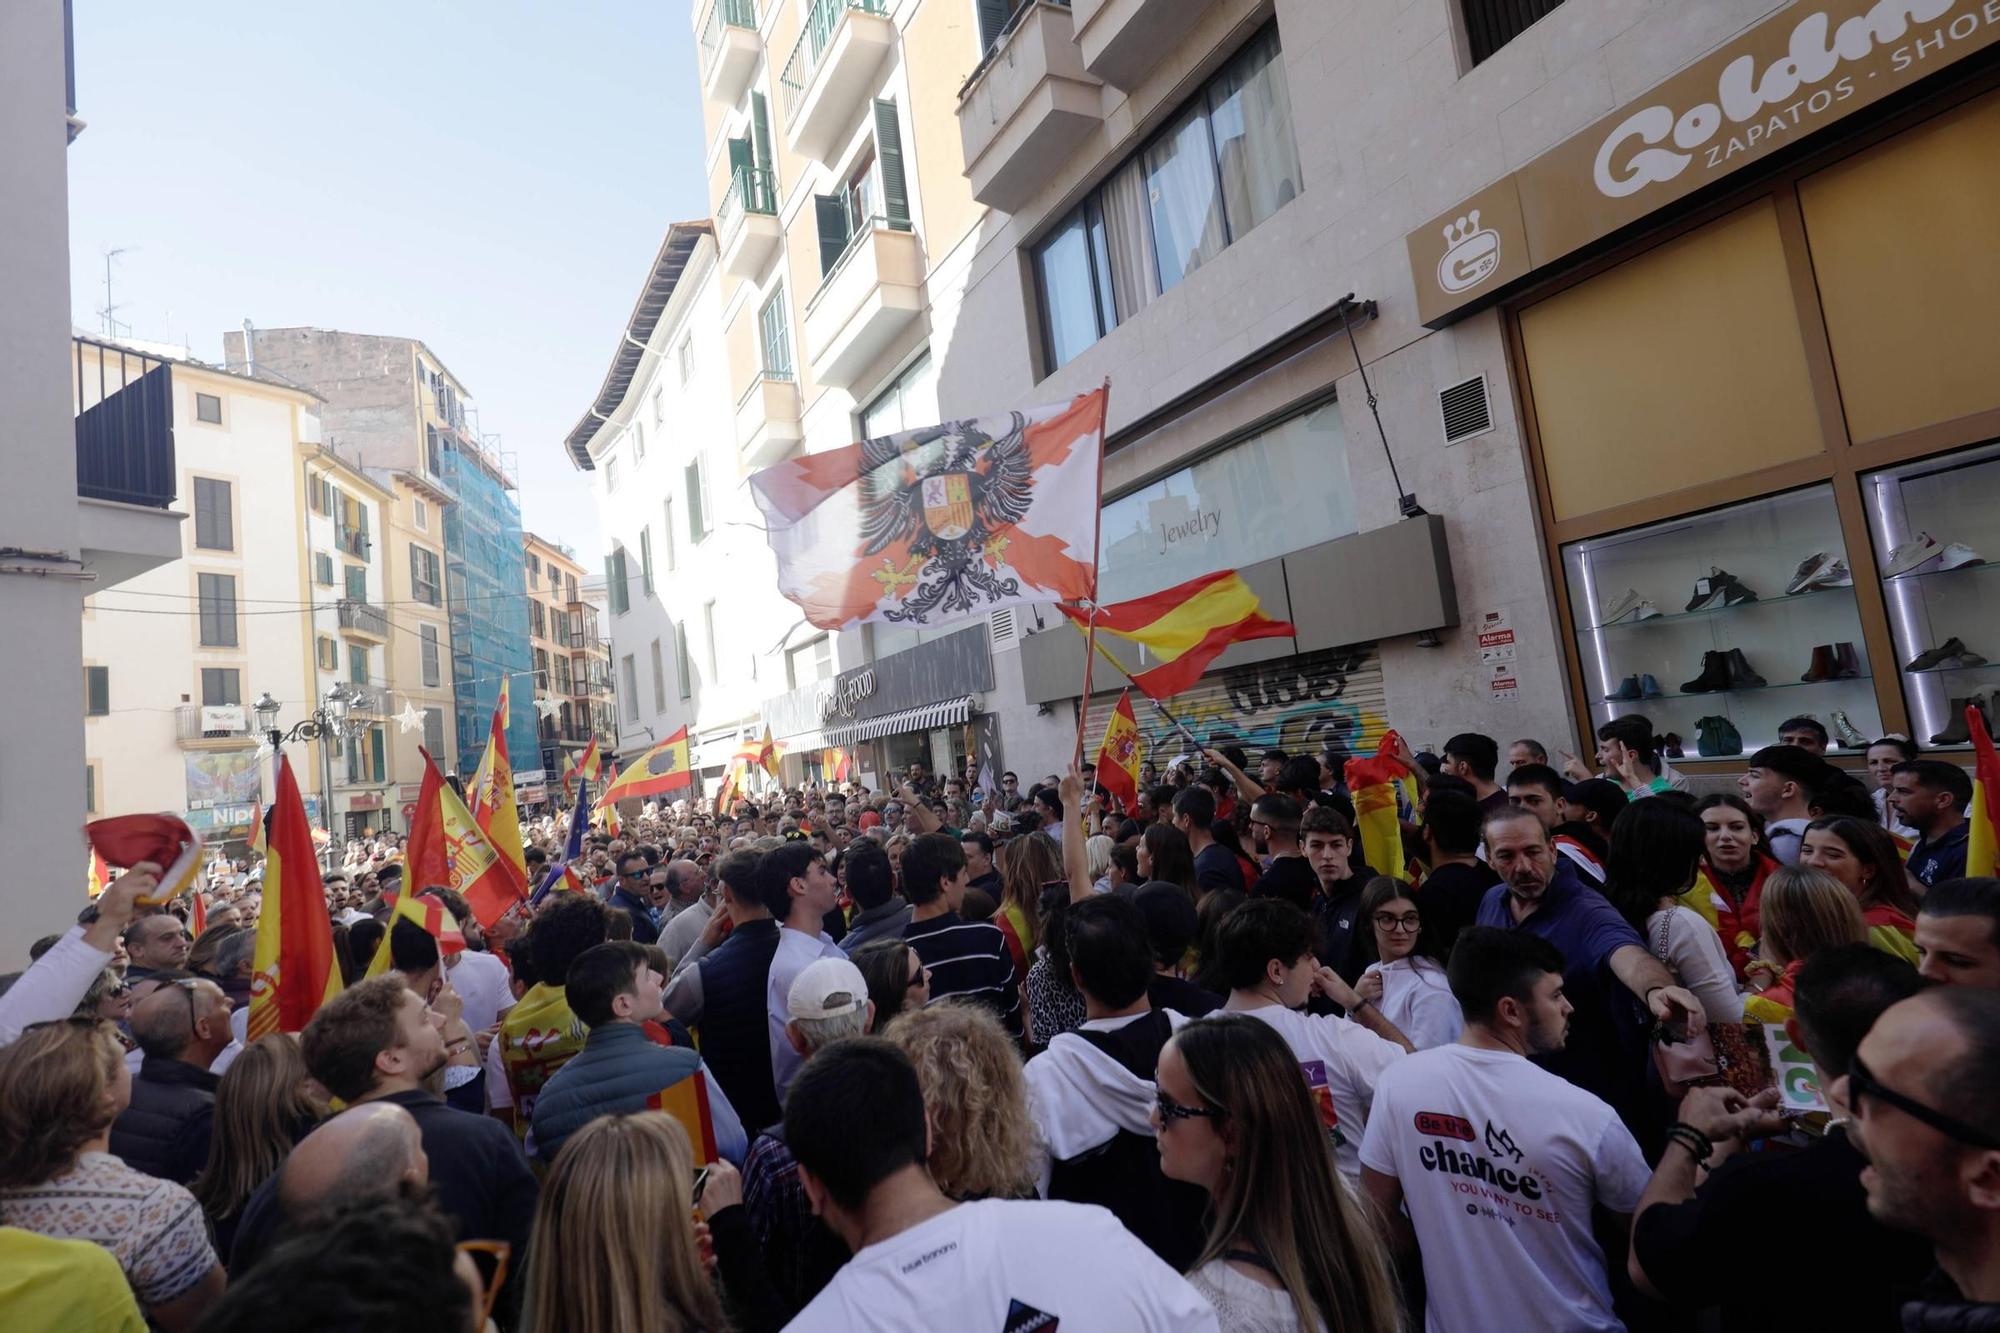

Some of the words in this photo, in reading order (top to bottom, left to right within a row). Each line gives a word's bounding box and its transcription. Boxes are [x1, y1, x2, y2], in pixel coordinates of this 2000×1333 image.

[1704, 76, 1855, 169] ZAPATOS
[1159, 504, 1222, 556] Jewelry
[1481, 633, 1512, 643] Alarma
[848, 668, 877, 704] FOOD
[1419, 1140, 1542, 1201] chance
[1450, 1181, 1478, 1195] YOU
[1513, 1201, 1532, 1216] TO
